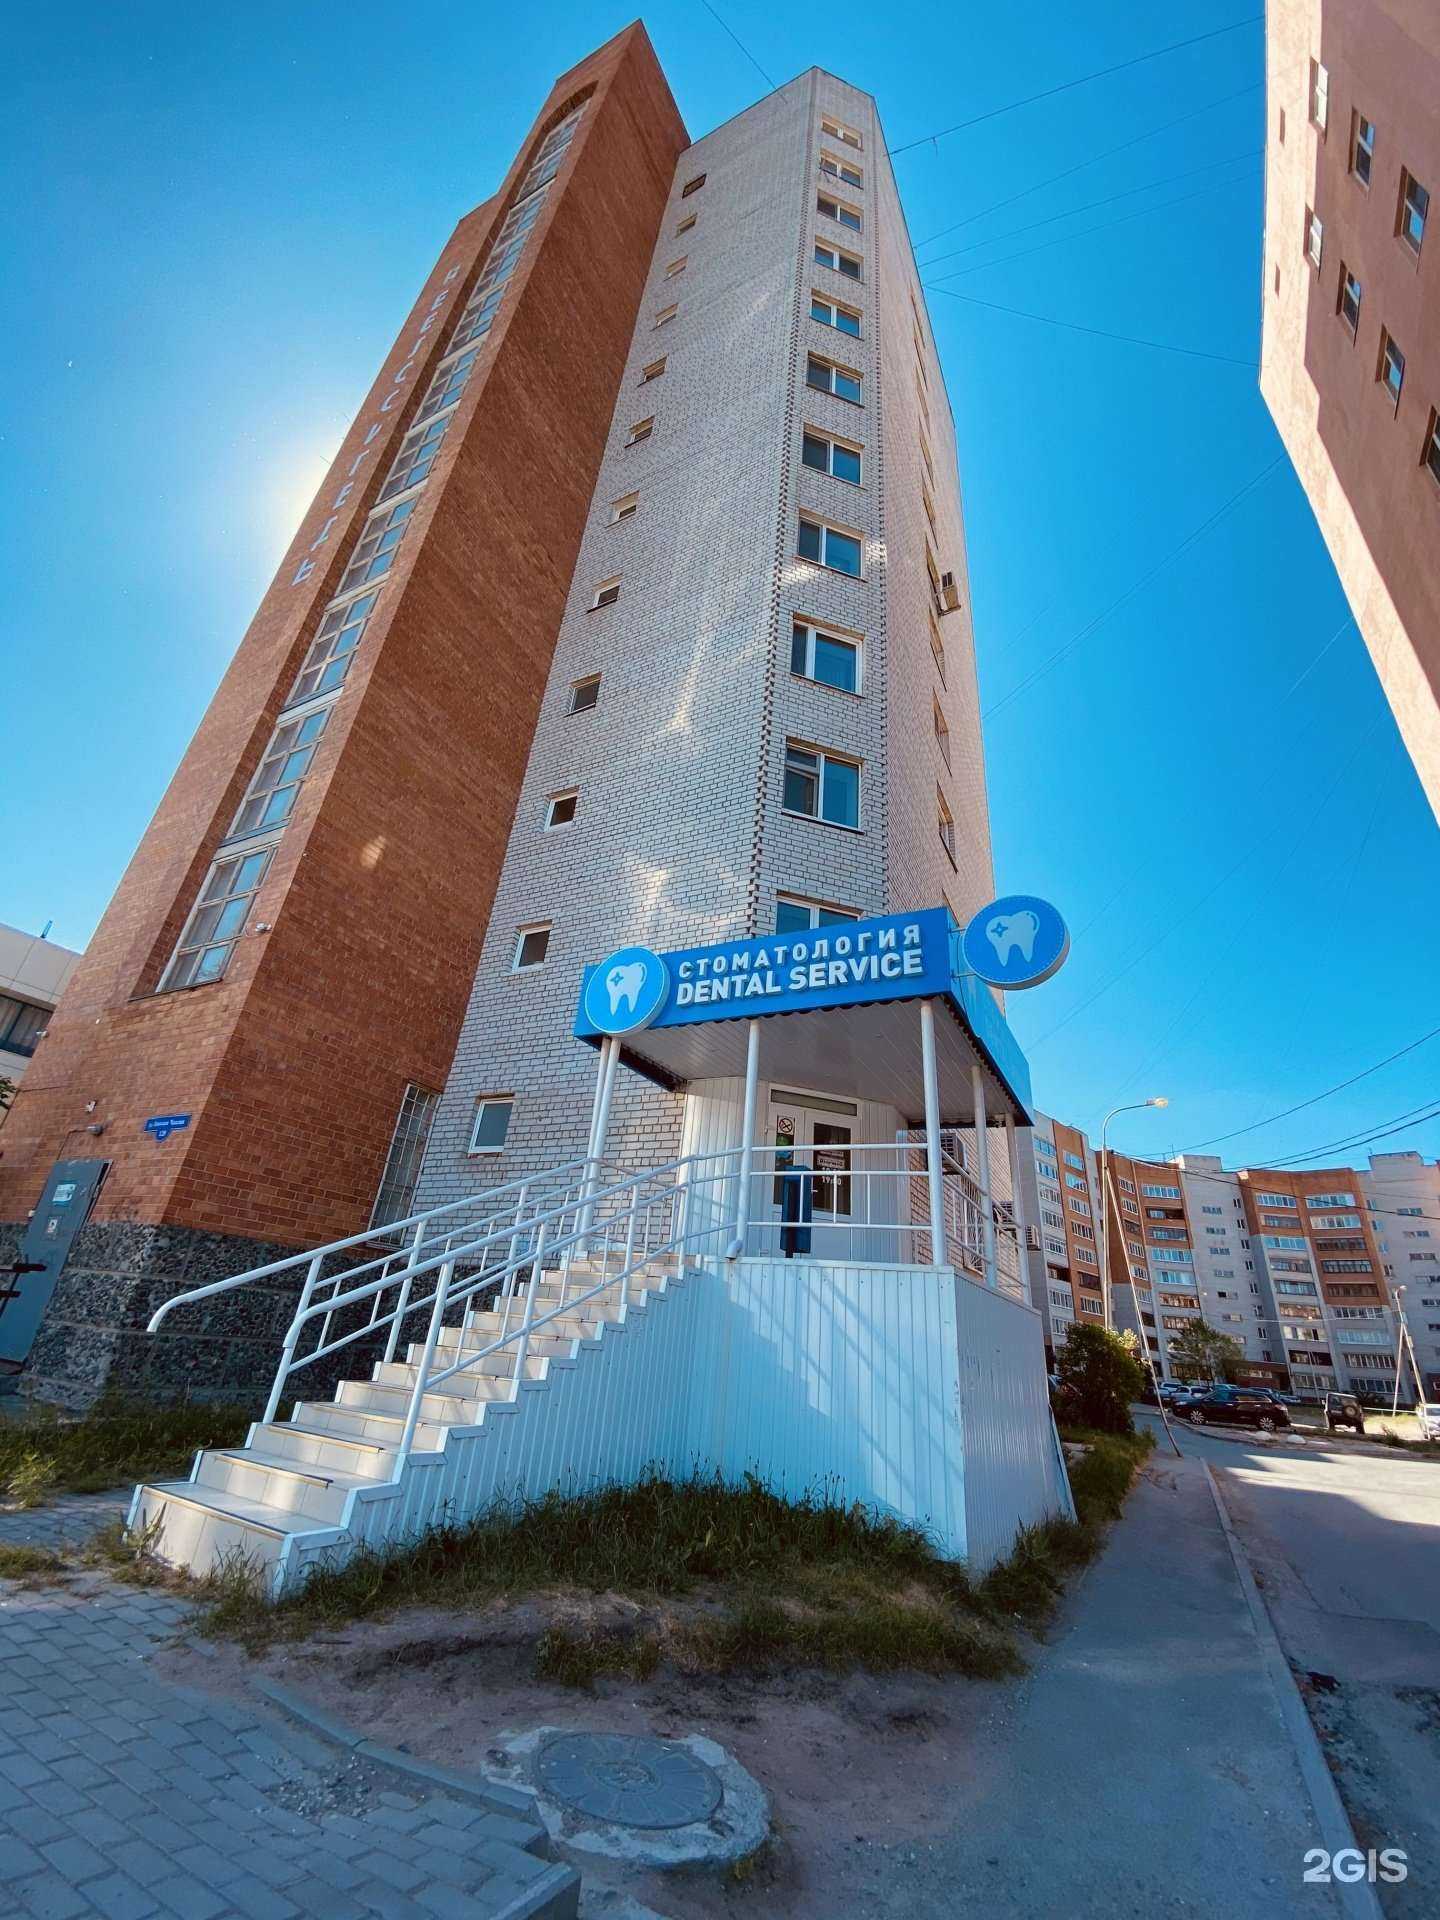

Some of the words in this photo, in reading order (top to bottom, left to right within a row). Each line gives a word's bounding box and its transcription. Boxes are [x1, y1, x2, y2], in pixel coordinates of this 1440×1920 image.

[676, 969, 783, 1006] DENTAL
[789, 948, 924, 992] SERVICE
[678, 924, 921, 979] СТОМАТОЛОГИЯ
